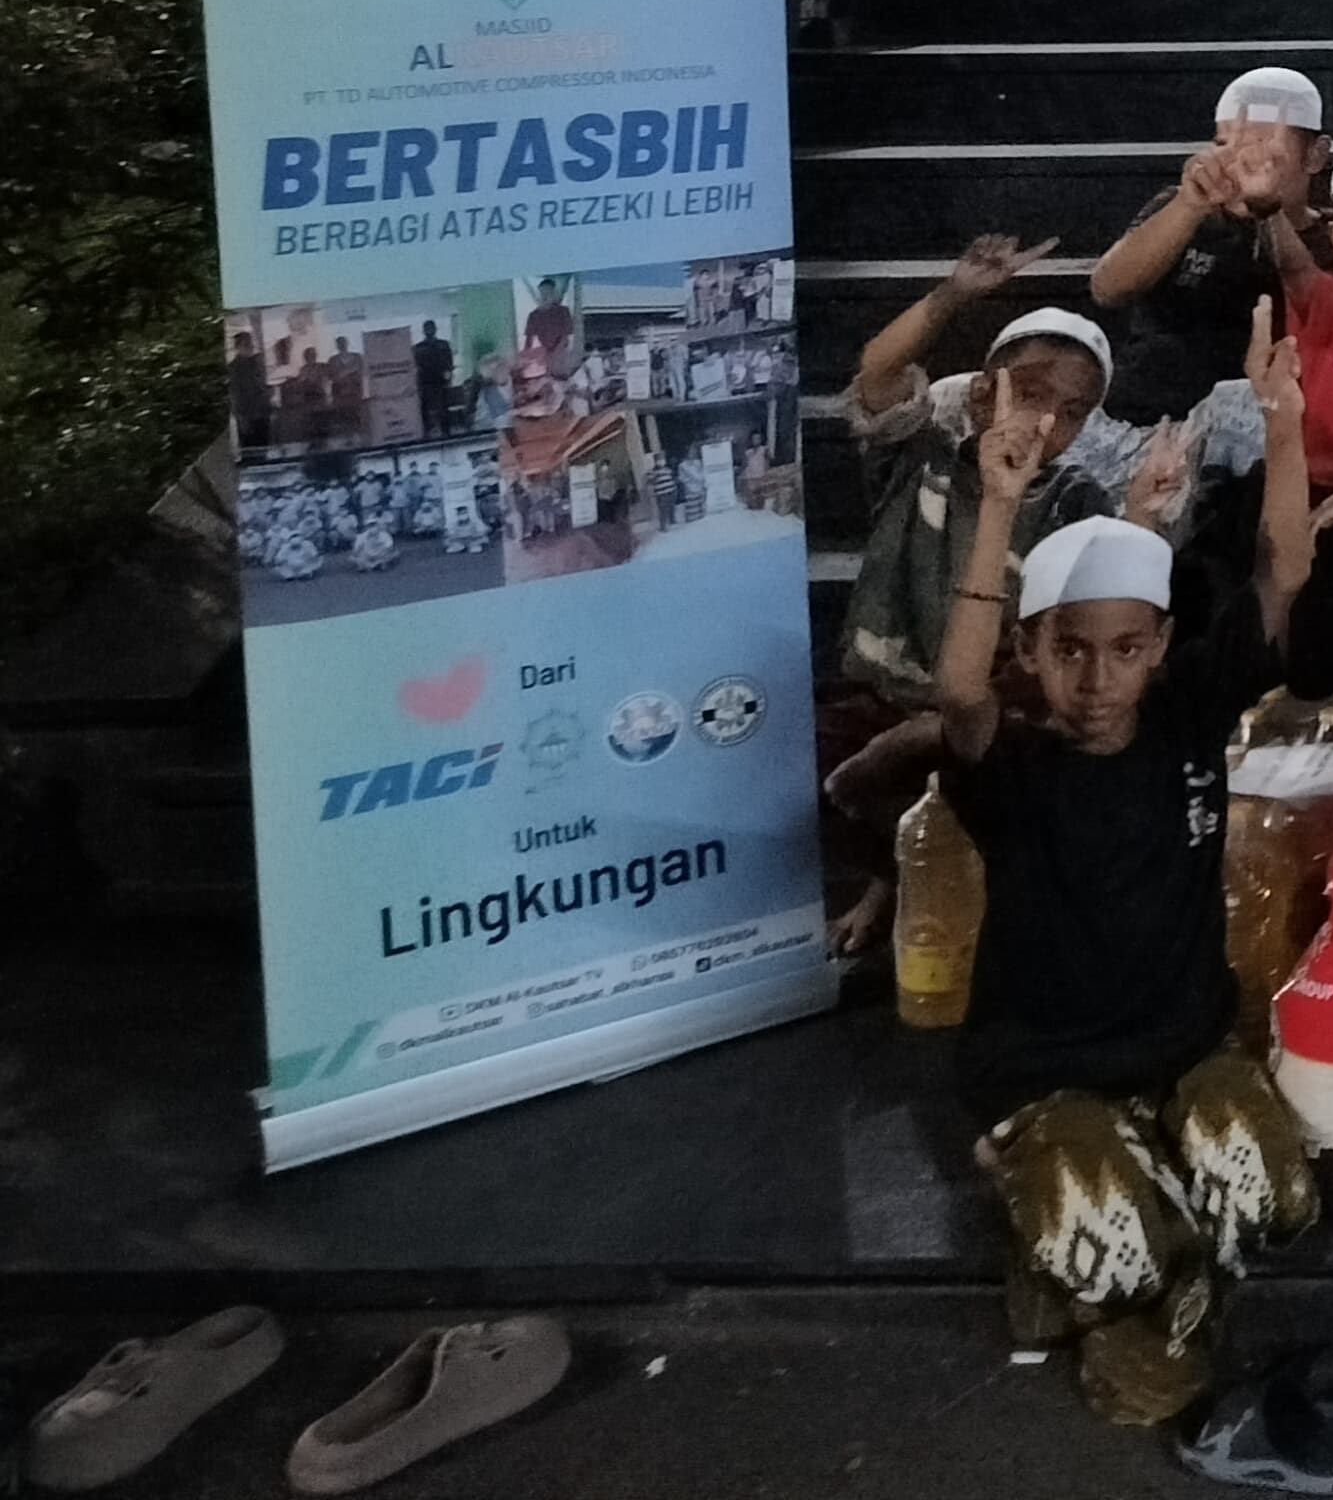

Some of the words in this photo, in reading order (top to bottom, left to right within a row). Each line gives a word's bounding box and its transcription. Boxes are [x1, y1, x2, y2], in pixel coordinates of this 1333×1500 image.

[476, 17, 552, 37] MASJID
[408, 43, 455, 72] AL
[367, 80, 489, 102] AUTOMOTIVE
[494, 70, 617, 93] COMPRESSOR
[621, 64, 716, 84] INDONESIA
[261, 101, 750, 212] BERTASBIH
[274, 211, 430, 257] BERBAGI
[438, 204, 528, 241] ATAS
[537, 195, 654, 231] REZEKI
[665, 182, 754, 217] LEBIH
[519, 656, 577, 689] Dari
[512, 815, 598, 853] Untuk
[380, 837, 727, 958] Lingkungan
